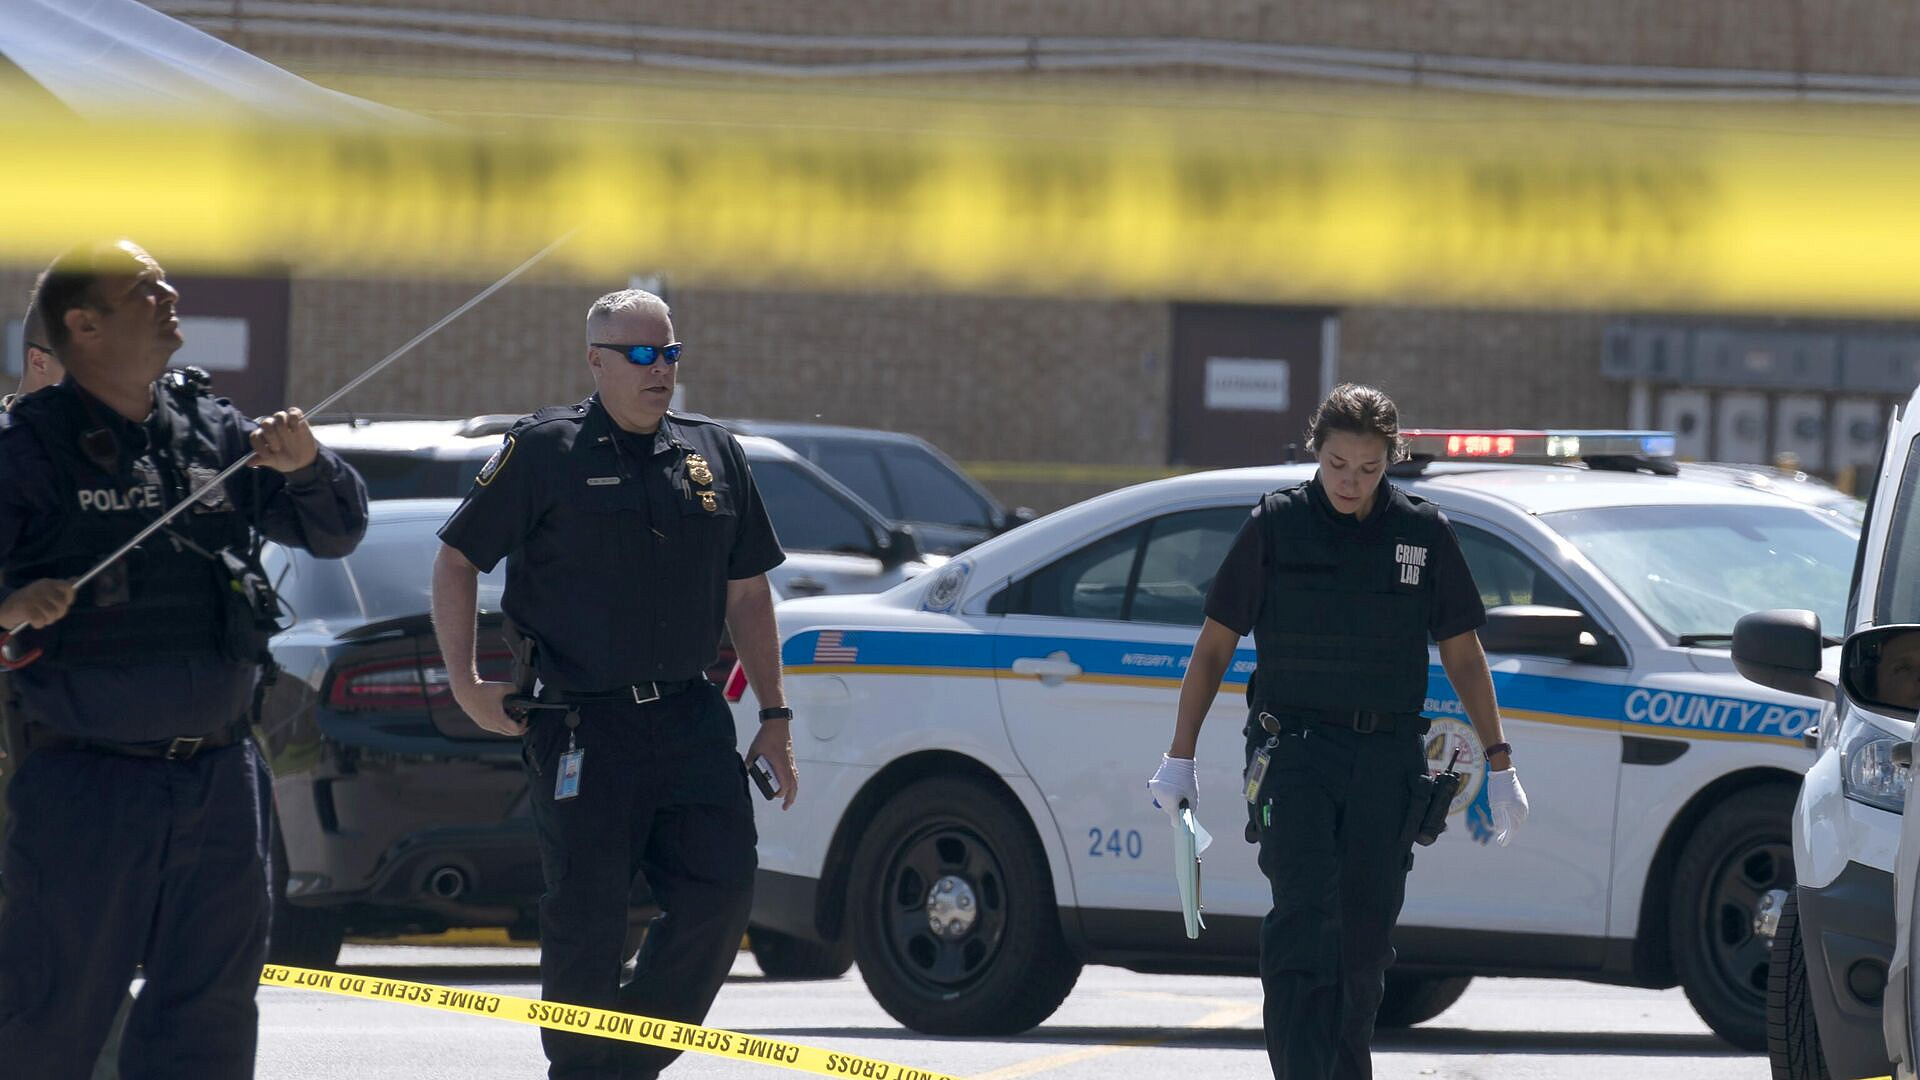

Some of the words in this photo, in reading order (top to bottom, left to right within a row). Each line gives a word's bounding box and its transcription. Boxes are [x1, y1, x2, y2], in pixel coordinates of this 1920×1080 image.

[78, 485, 160, 511] POLICE
[1395, 544, 1427, 567] CRIME
[1400, 564, 1420, 585] LAB
[1624, 689, 1762, 731] COUNTY
[1088, 827, 1143, 859] 240
[263, 967, 290, 982] CR
[295, 971, 333, 988] NOT
[339, 976, 366, 992] DO
[371, 981, 434, 1003] SCENE
[438, 990, 500, 1013] CRIME
[527, 1002, 590, 1028] CROSS
[595, 1012, 634, 1035] NOT
[639, 1020, 667, 1041] DO
[670, 1025, 733, 1052] SCENE
[737, 1036, 800, 1063] CRIME
[826, 1054, 889, 1080] CROSS
